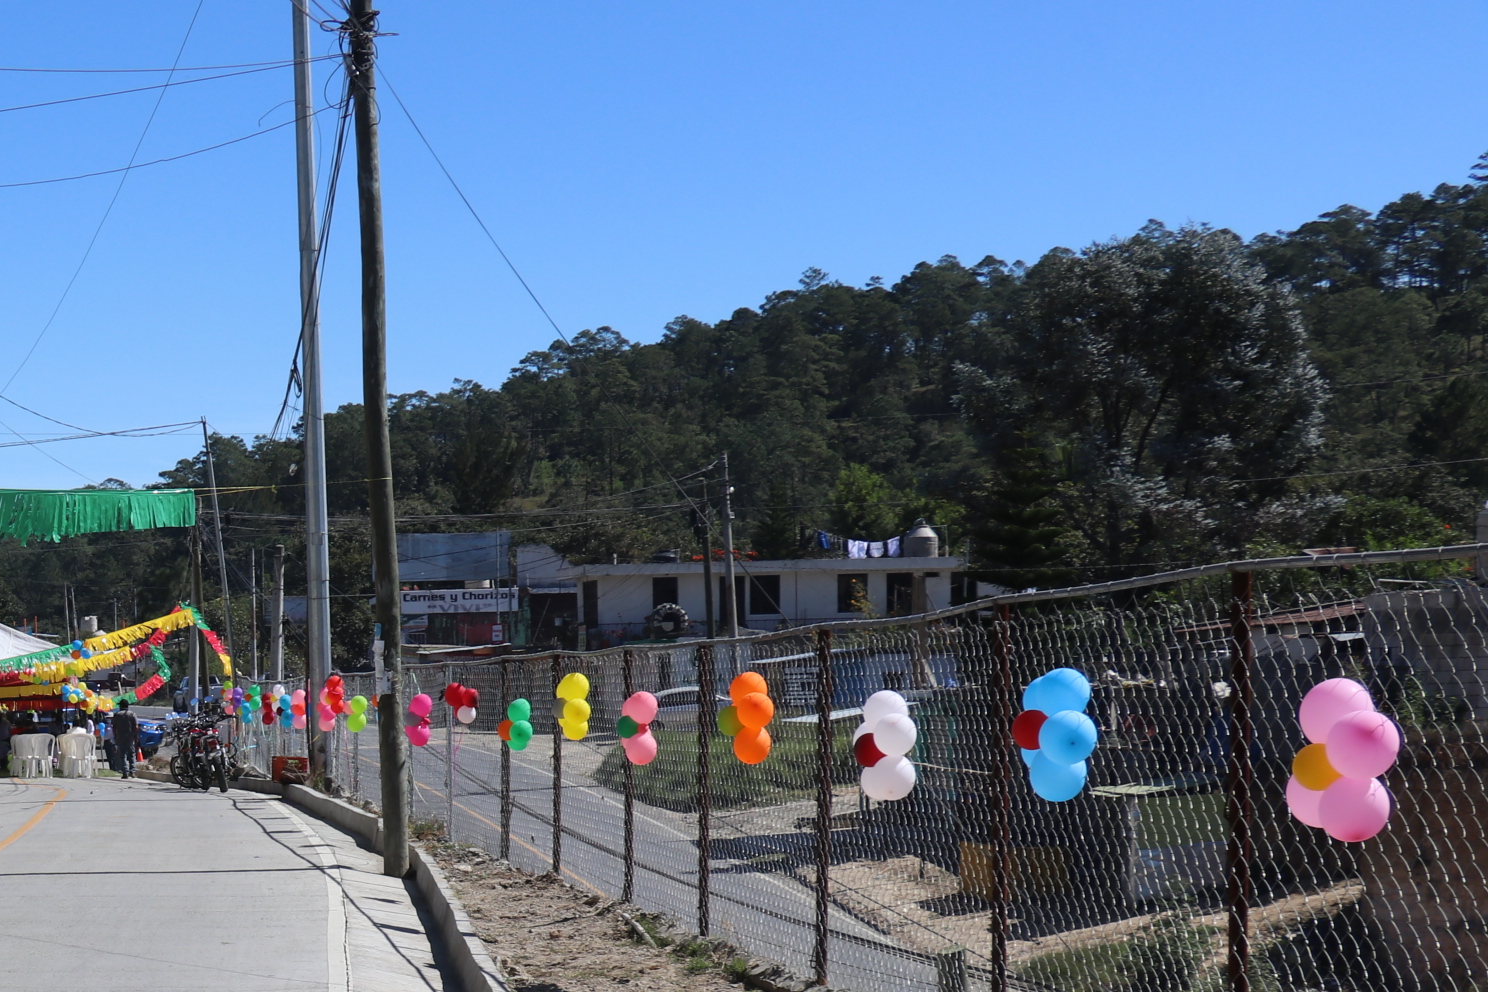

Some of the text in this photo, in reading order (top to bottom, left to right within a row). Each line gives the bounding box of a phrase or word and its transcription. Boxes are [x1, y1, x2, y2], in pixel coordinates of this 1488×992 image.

[402, 591, 516, 603] Carnes y Chorizos
